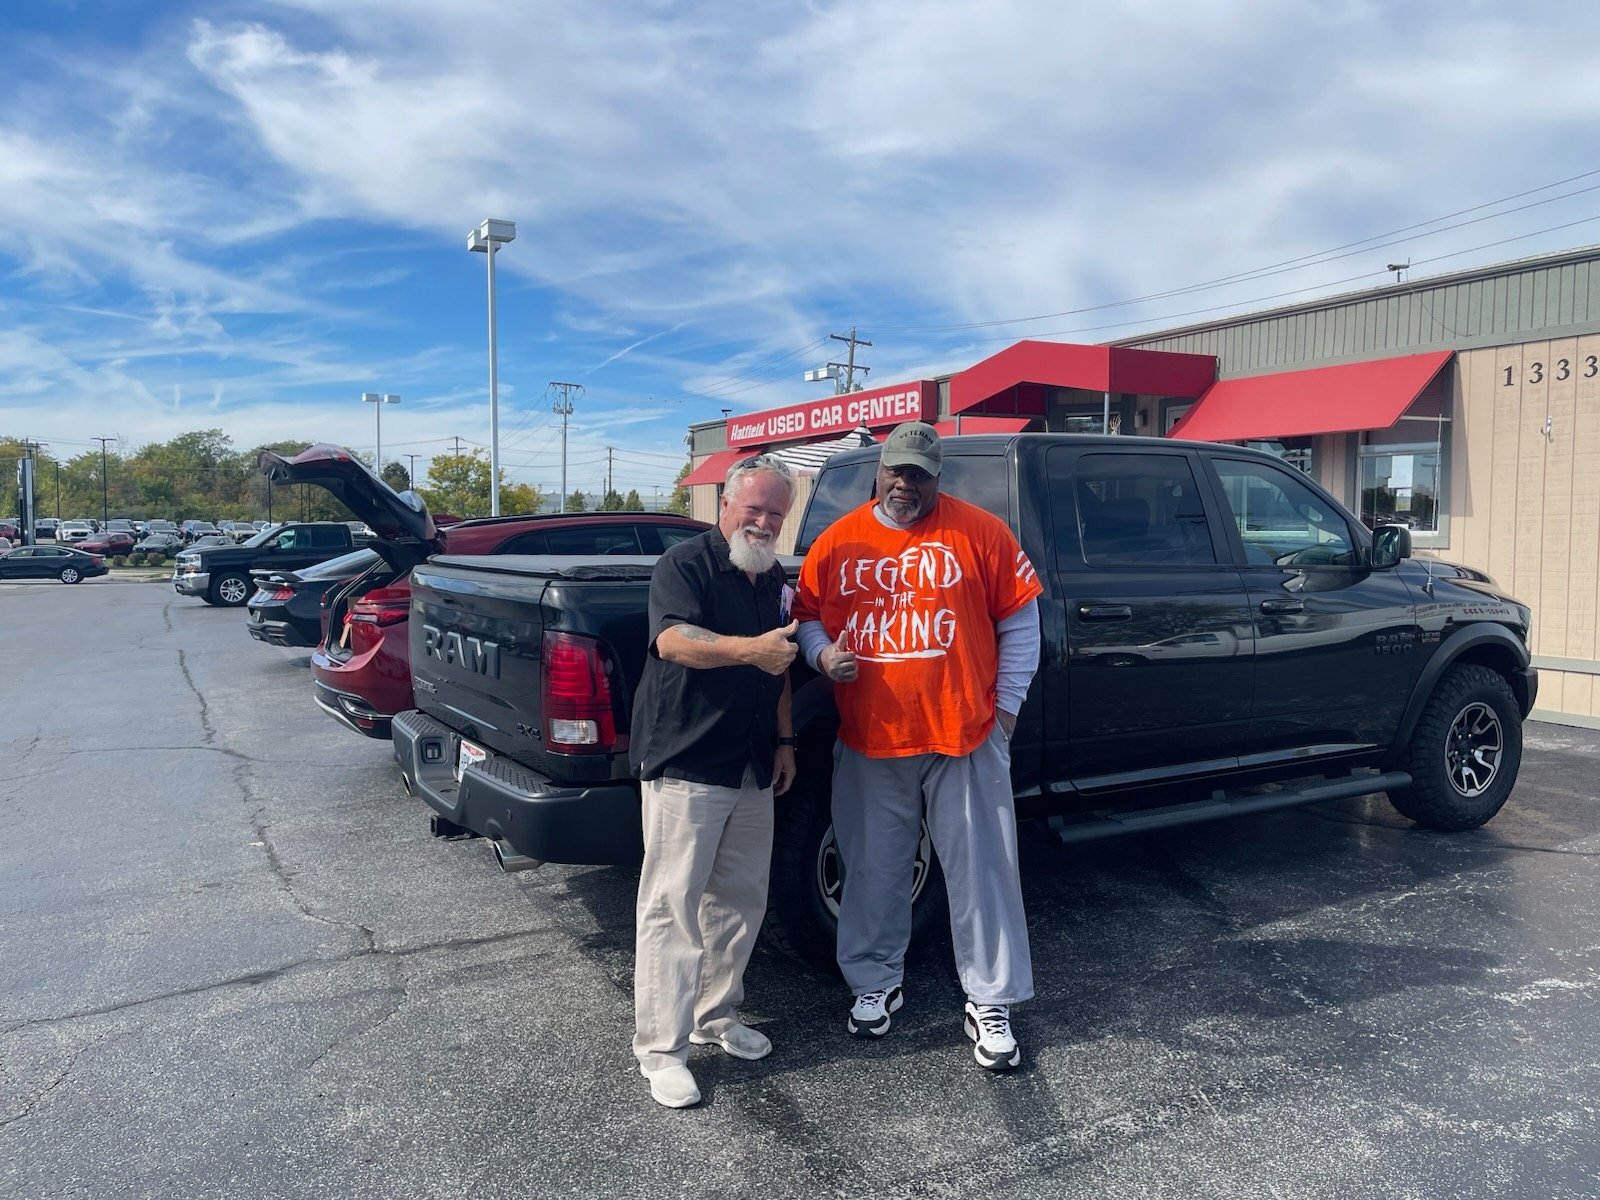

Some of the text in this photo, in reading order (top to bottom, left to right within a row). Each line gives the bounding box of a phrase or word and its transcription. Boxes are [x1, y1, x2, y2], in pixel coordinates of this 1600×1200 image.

[1503, 355, 1599, 387] 1333
[730, 390, 920, 441] Hatfield USED CAR CENTER
[899, 429, 934, 444] VETERAN
[839, 542, 963, 596] LEGEND
[874, 591, 917, 610] IN THE
[845, 608, 957, 652] MAKING
[1375, 633, 1413, 645] RAM
[422, 624, 500, 680] RAM
